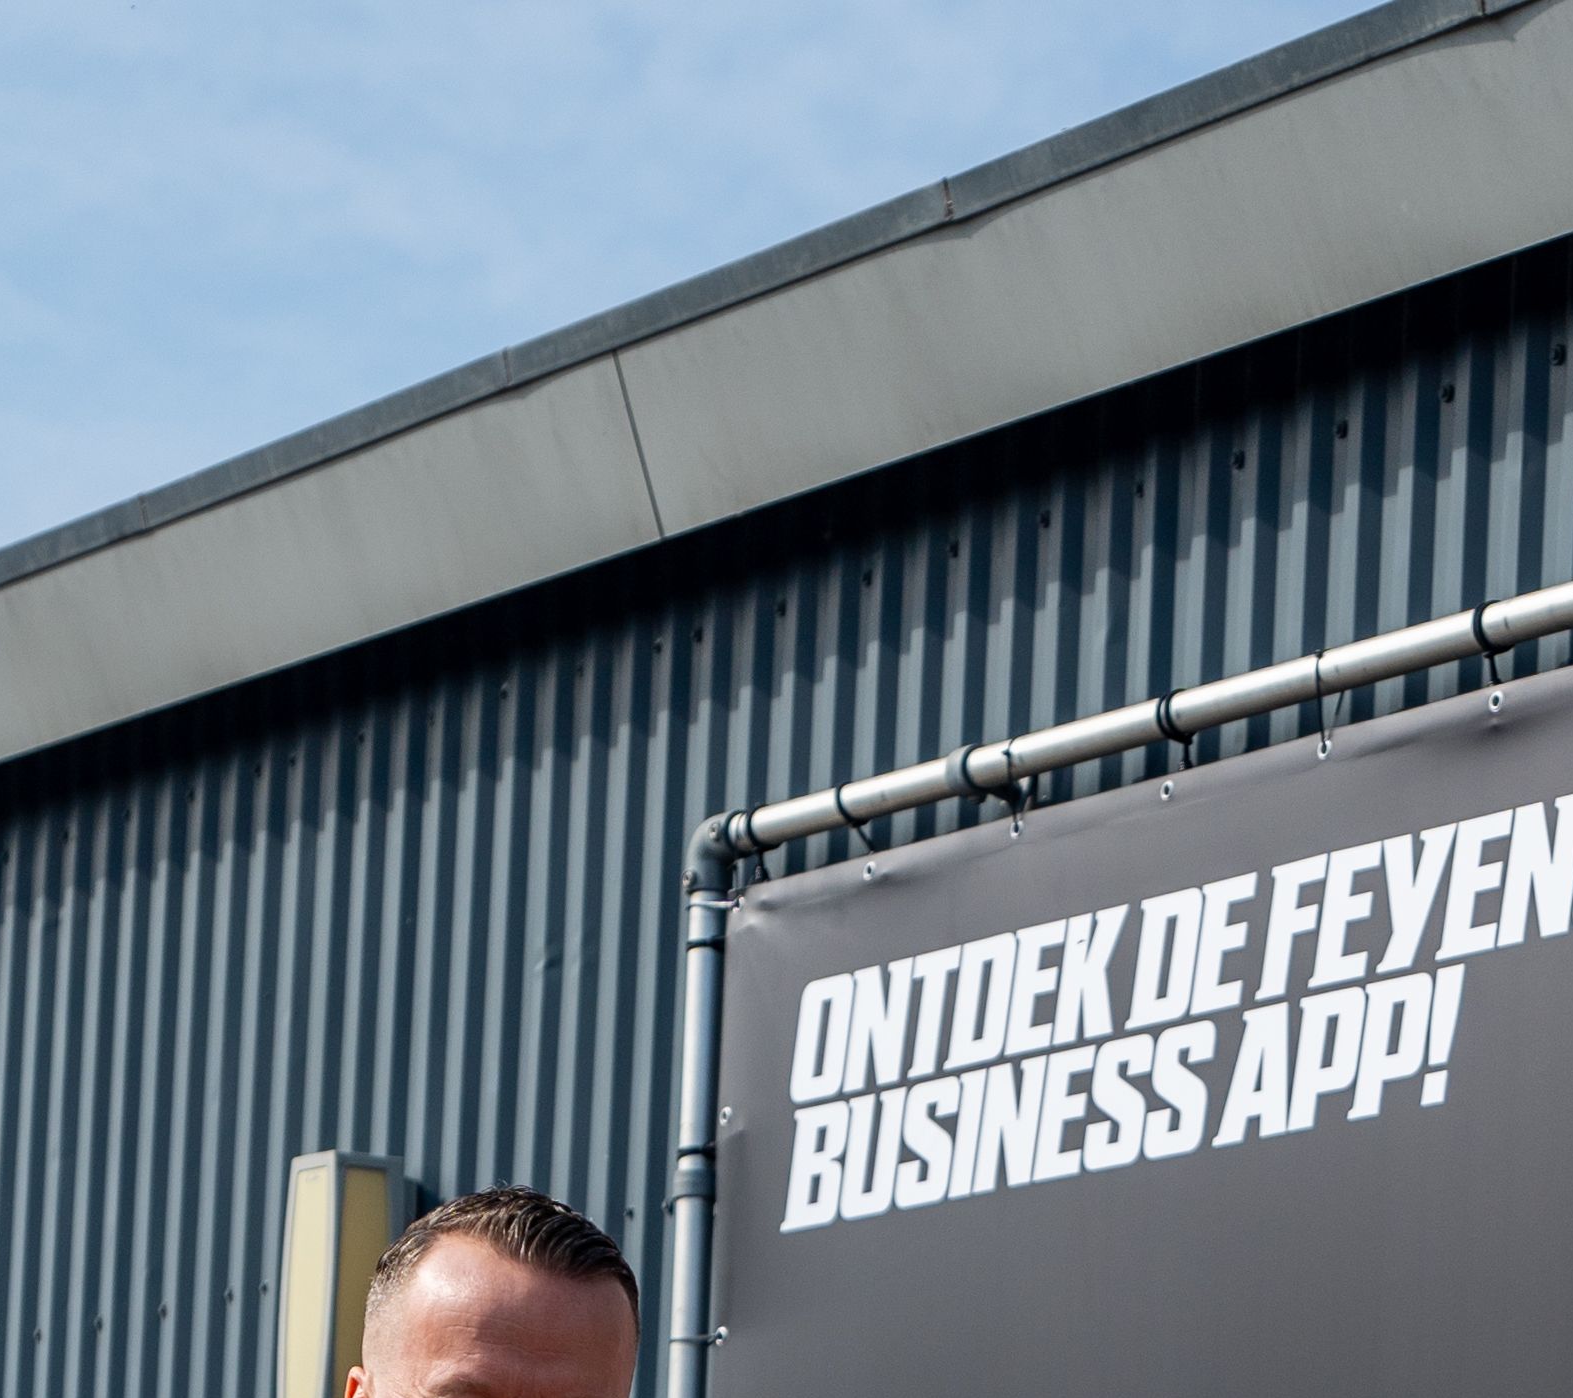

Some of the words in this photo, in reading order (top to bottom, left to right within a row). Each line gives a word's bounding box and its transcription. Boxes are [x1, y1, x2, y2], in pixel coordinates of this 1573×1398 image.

[780, 1019, 1216, 1233] BUSINESS
[1213, 963, 1465, 1148] APP!
[790, 904, 1129, 1104] ONTDEK
[1125, 871, 1257, 1031] DE
